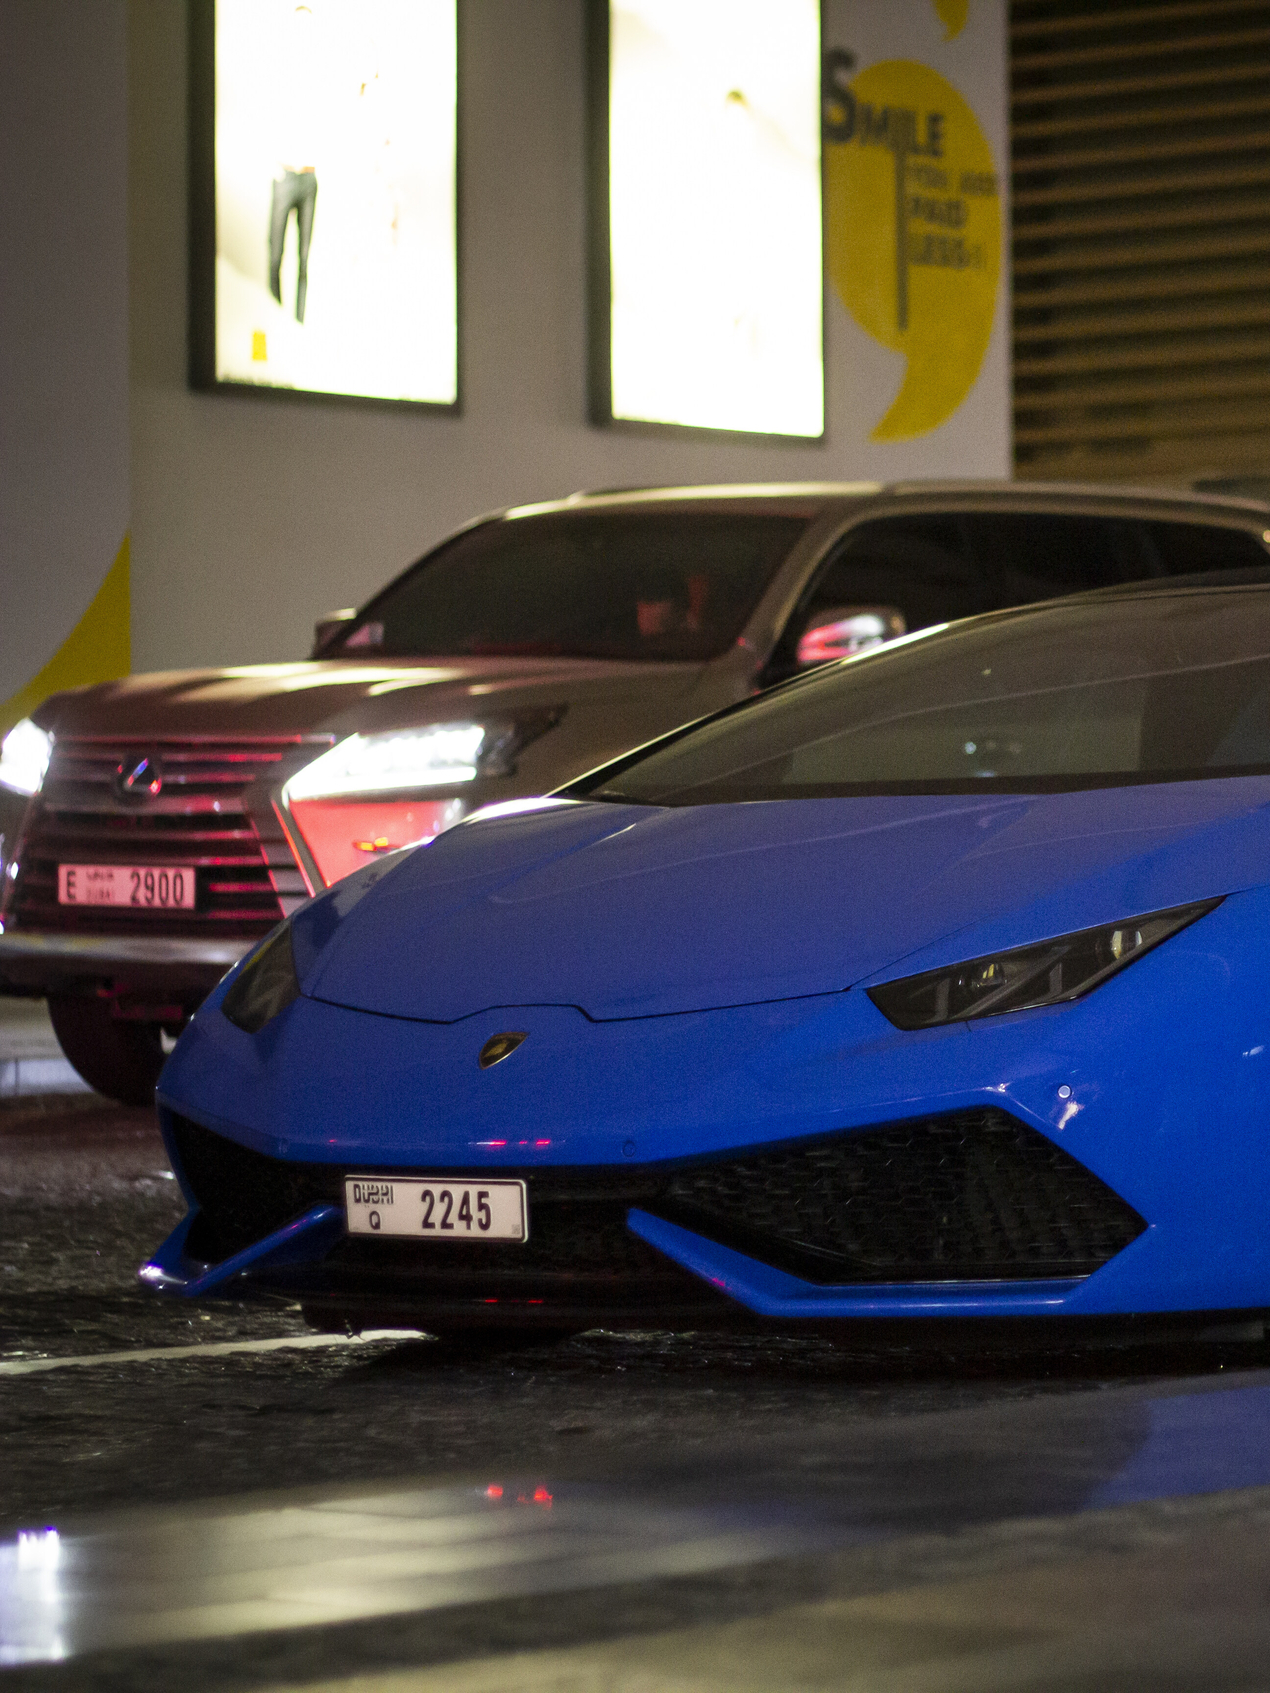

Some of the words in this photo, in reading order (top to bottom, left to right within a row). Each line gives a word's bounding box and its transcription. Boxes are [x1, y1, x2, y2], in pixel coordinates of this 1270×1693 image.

[823, 48, 944, 158] SMILE
[66, 870, 77, 900] E
[130, 870, 184, 906] 2900
[368, 1210, 381, 1230] Q
[420, 1189, 492, 1231] 2245
